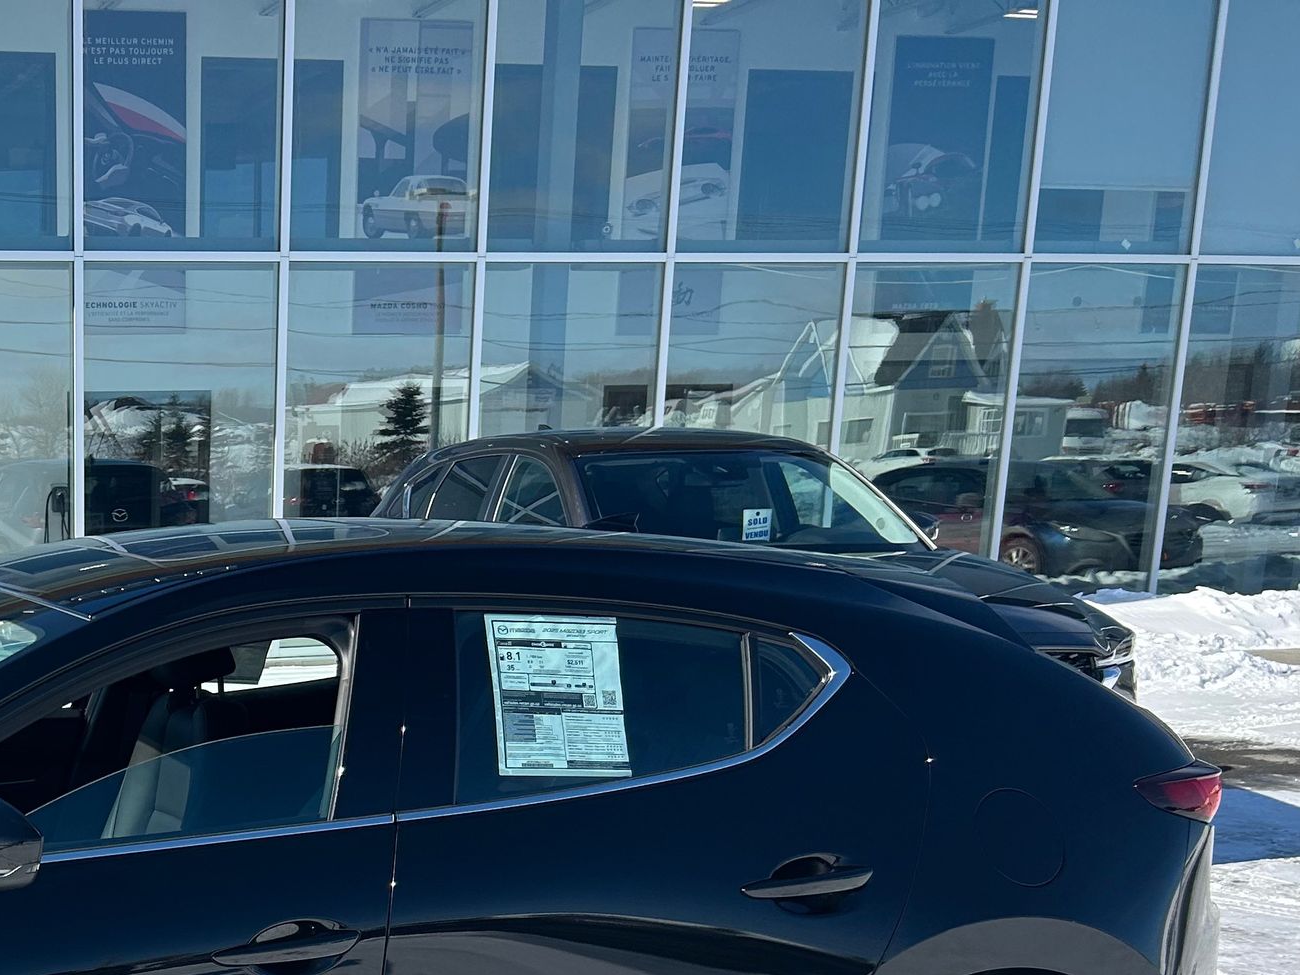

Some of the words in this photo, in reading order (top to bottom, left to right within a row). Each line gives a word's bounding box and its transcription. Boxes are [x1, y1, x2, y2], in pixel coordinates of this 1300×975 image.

[95, 37, 138, 45] MEILLEUR
[140, 38, 174, 46] CHEMIN
[109, 47, 126, 55] PAS
[128, 47, 174, 55] TOUJOURS
[391, 47, 421, 55] JAMAIS
[93, 57, 104, 65] LE
[107, 57, 130, 65] PLUS
[131, 57, 162, 65] DIRECT
[384, 56, 396, 64] NE
[434, 57, 450, 65] PAS
[378, 65, 390, 73] NE
[391, 65, 412, 74] PEUT
[436, 66, 455, 75] FAIT
[83, 301, 138, 309] ECHNOLOGIE
[140, 301, 178, 309] SKYACTIV
[370, 302, 398, 310] MAZDA
[747, 516, 768, 526] SOLD
[745, 530, 769, 540] VENDU
[506, 651, 521, 661] 8.1
[506, 664, 516, 672] 35
